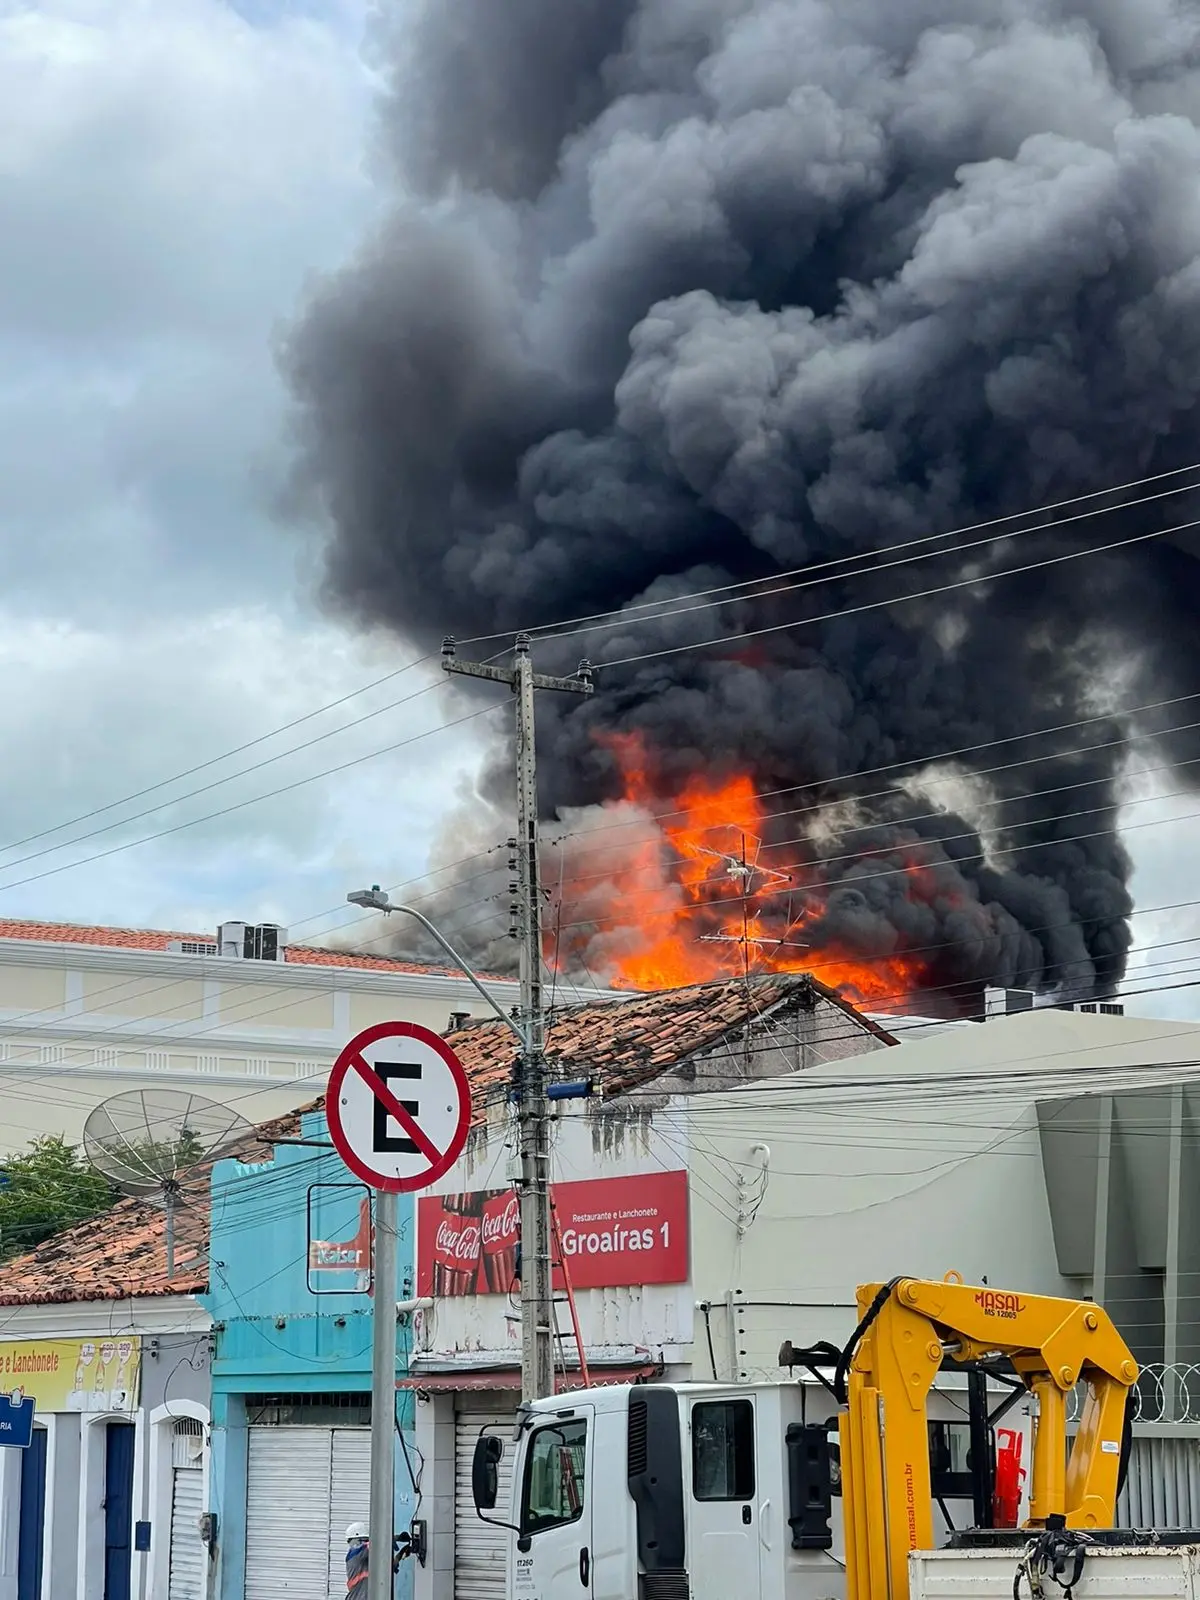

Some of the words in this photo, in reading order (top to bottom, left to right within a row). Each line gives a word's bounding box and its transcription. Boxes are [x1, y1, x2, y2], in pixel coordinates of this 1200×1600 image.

[373, 1061, 422, 1154] E
[572, 1211, 612, 1223] Restaurante
[612, 1211, 618, 1220] e
[618, 1207, 658, 1219] Lanchonete
[562, 1223, 654, 1256] Groaíras
[660, 1221, 670, 1248] 1
[974, 1291, 1026, 1313] MASAL
[984, 1308, 996, 1317] MS
[5, 1356, 10, 1373] e
[12, 1349, 59, 1373] Lanchonete
[0, 1421, 12, 1430] RIA
